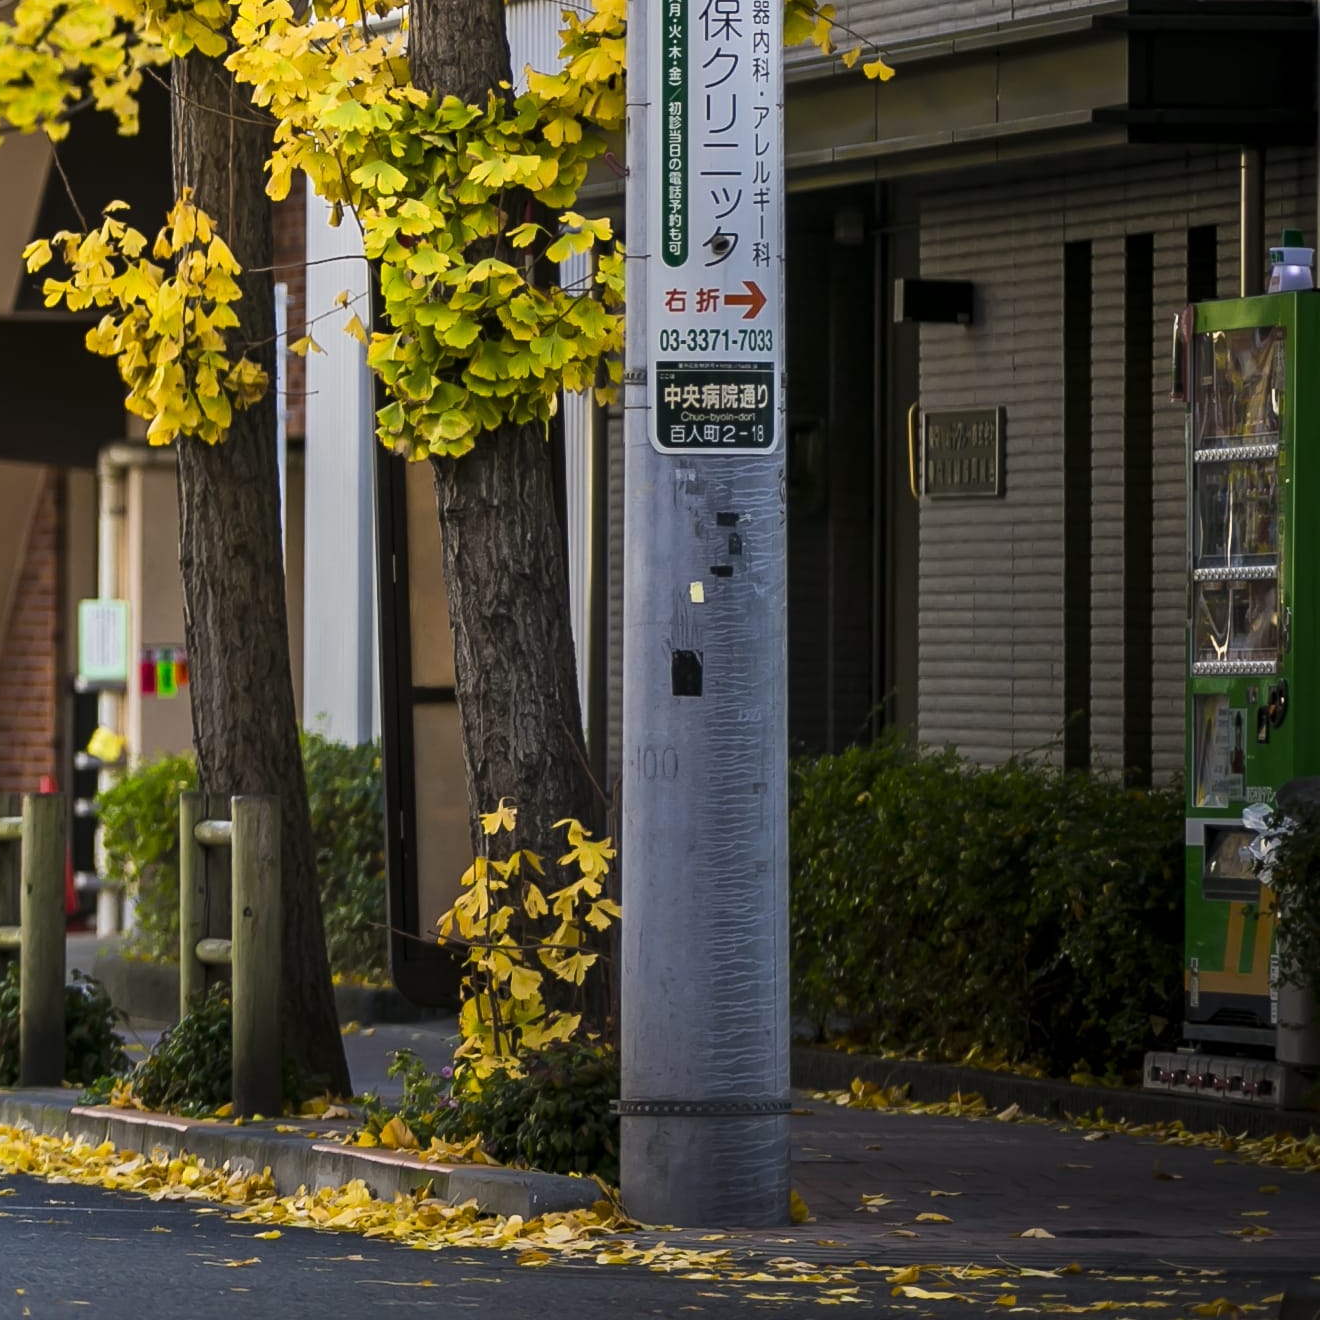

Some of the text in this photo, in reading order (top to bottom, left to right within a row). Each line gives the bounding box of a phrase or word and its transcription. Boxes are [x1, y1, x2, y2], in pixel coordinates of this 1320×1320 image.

[664, 287, 720, 313] 右折
[659, 328, 773, 352] 03-3371-7033
[664, 383, 769, 410] 中央病院通り
[680, 411, 756, 423] Chuo-byoin-dori
